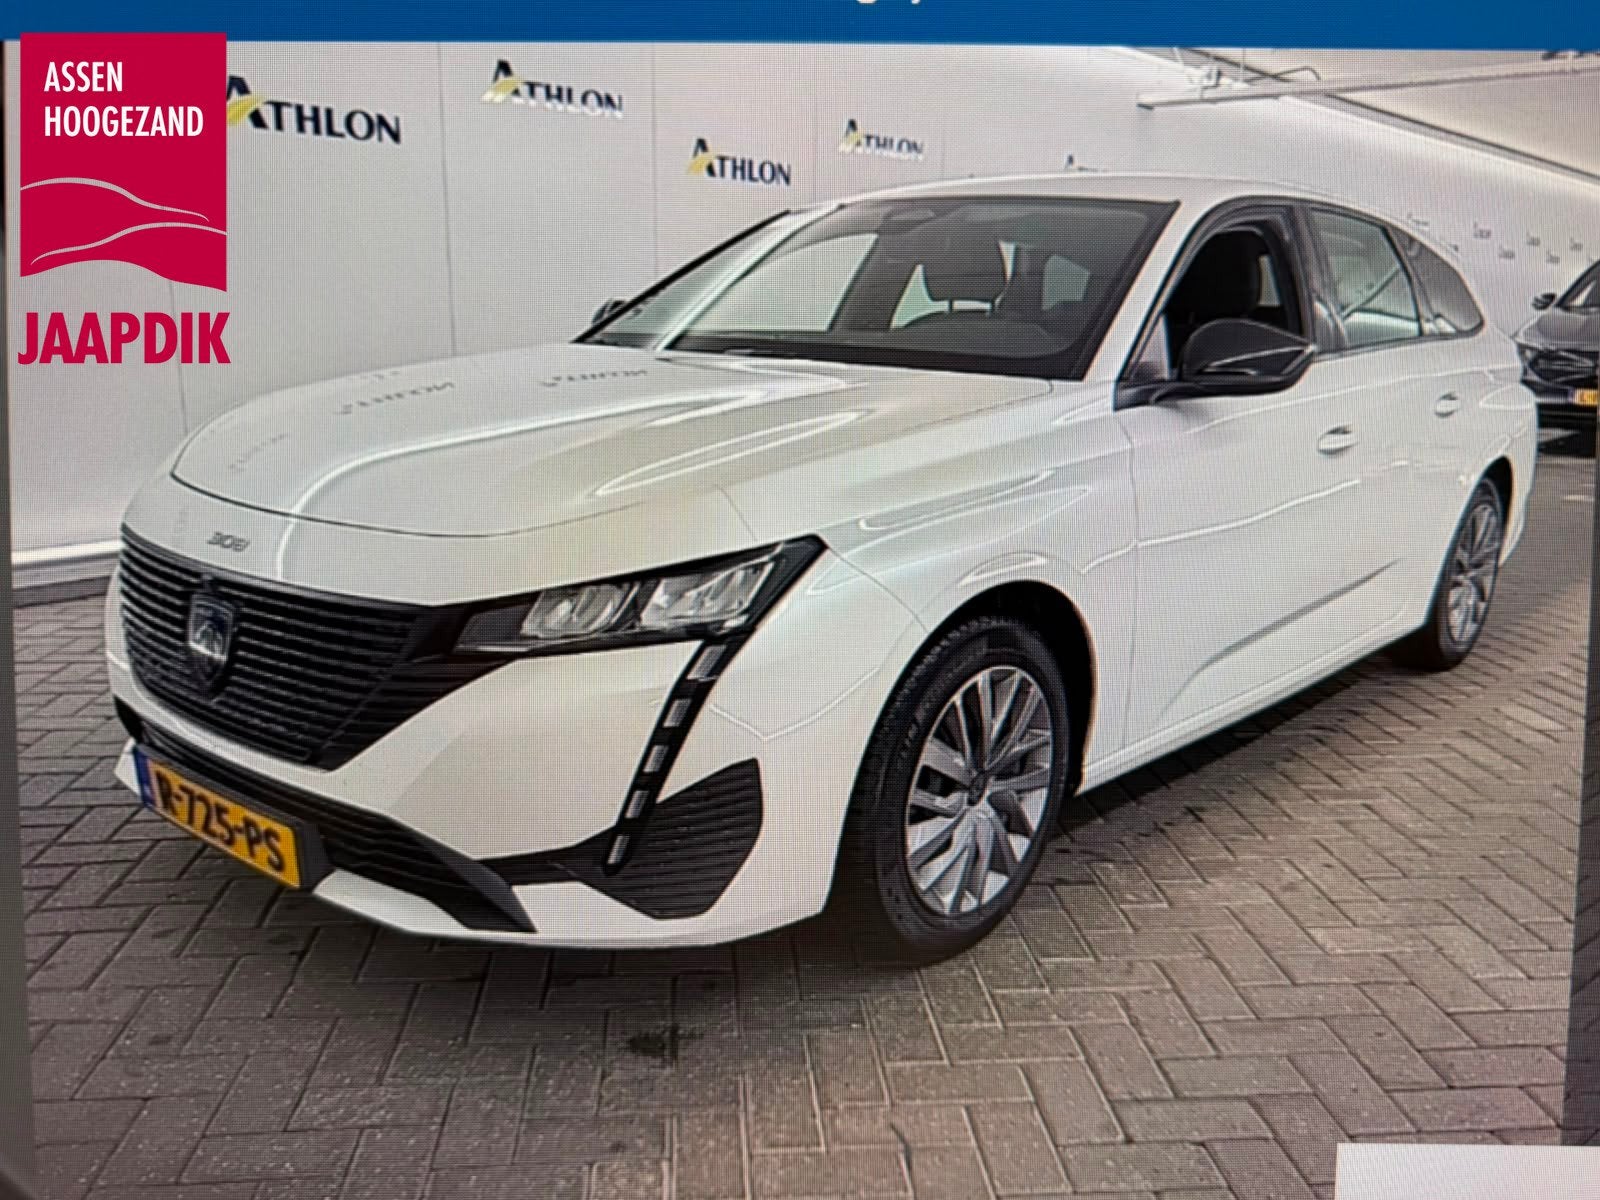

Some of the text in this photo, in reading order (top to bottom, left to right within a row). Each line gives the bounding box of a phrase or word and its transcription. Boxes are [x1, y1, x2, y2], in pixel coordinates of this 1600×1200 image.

[226, 75, 401, 145] ATHLON
[483, 59, 623, 117] ATHLON
[686, 138, 792, 186] ATHLON
[840, 118, 925, 161] ATHLON
[154, 770, 286, 873] R-725-PS
